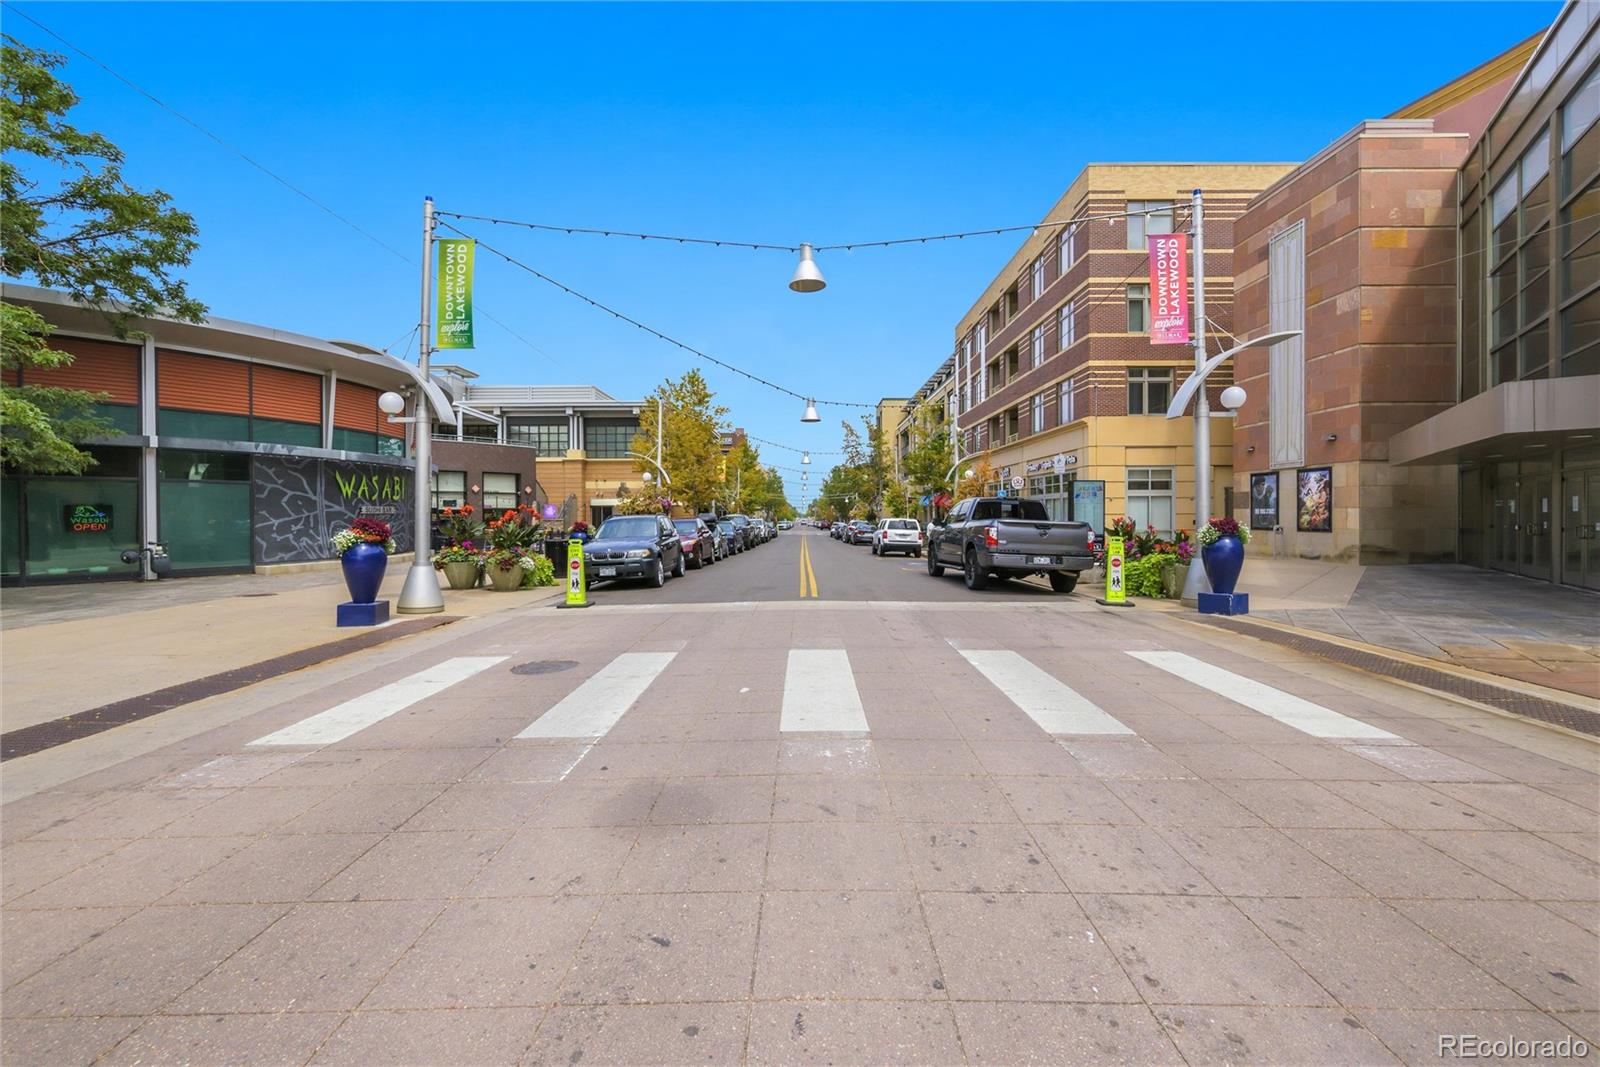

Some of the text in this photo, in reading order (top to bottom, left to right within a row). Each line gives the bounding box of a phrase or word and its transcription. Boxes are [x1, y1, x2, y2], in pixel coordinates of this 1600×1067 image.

[445, 243, 455, 320] DOWNTOWN
[456, 243, 467, 320] LAKEWOOD
[1157, 239, 1168, 315] DOWNTOWN
[1169, 239, 1179, 315] LAKEWOOD
[335, 470, 405, 501] WASABI
[74, 523, 106, 531] OPEN
